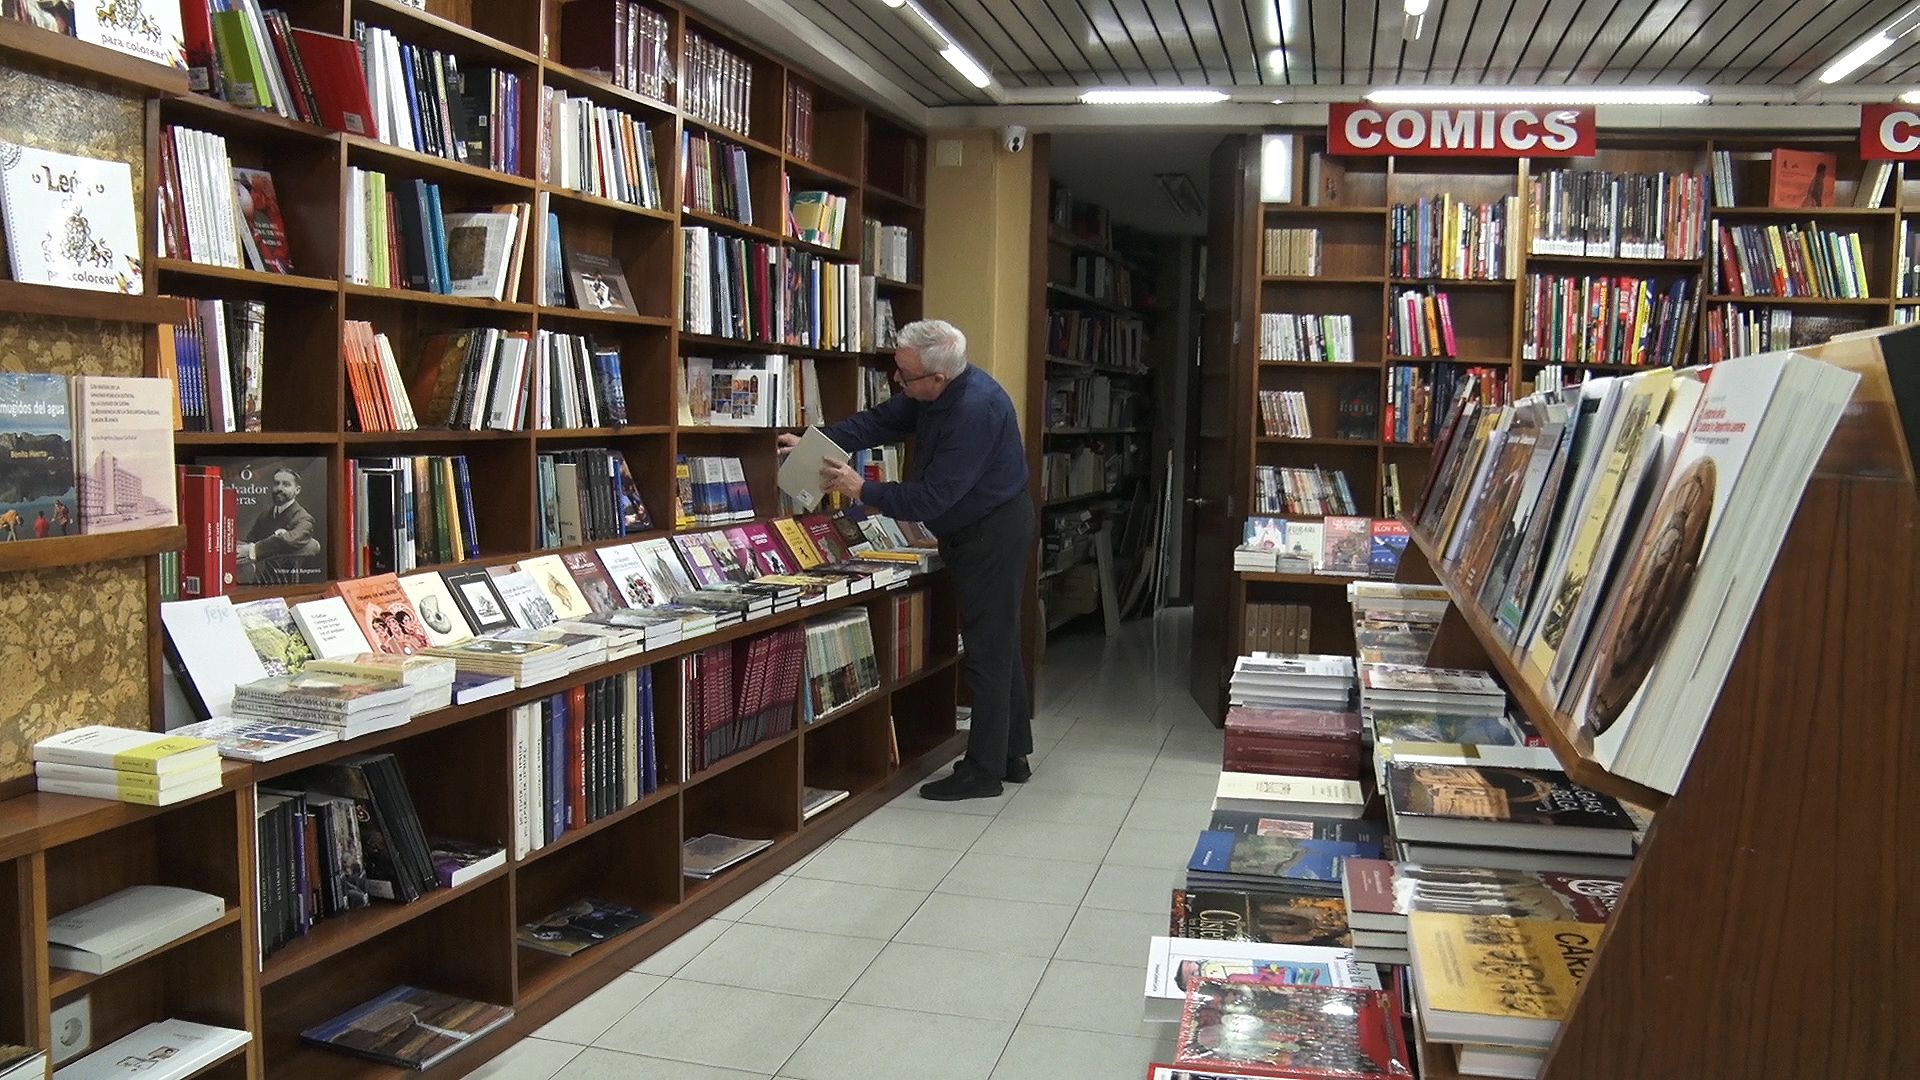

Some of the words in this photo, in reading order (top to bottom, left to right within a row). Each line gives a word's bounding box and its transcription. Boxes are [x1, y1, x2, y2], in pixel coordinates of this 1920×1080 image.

[101, 34, 124, 49] para
[126, 39, 165, 61] colorear
[1345, 109, 1578, 150] COMICS
[1880, 111, 1920, 153] C
[41, 165, 84, 194] Leó
[72, 271, 115, 285] colorear
[34, 400, 46, 415] del
[47, 403, 65, 418] agua
